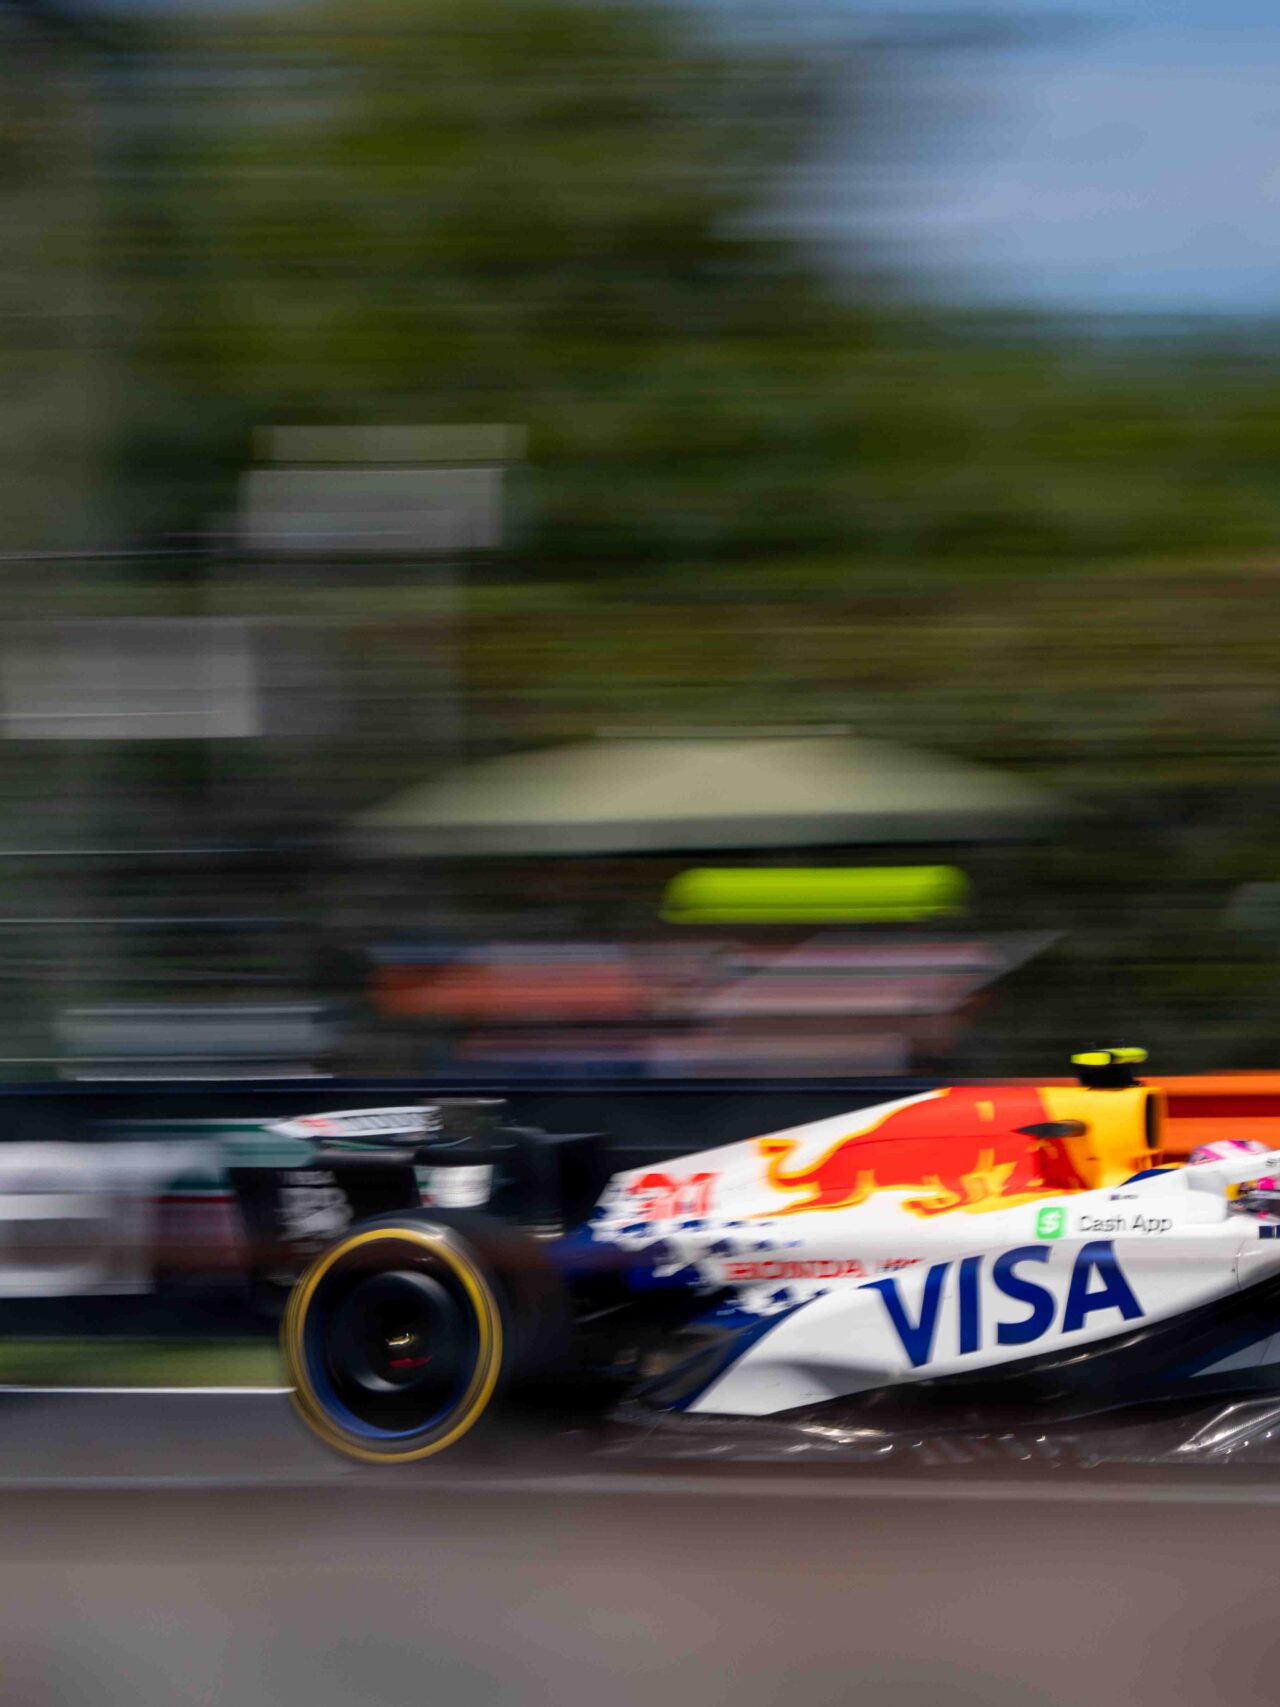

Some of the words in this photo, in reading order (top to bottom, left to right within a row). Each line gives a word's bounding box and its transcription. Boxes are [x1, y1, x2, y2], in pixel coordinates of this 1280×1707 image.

[1079, 1215, 1126, 1232] Cash
[1132, 1214, 1173, 1233] App
[857, 1241, 1144, 1368] VISA
